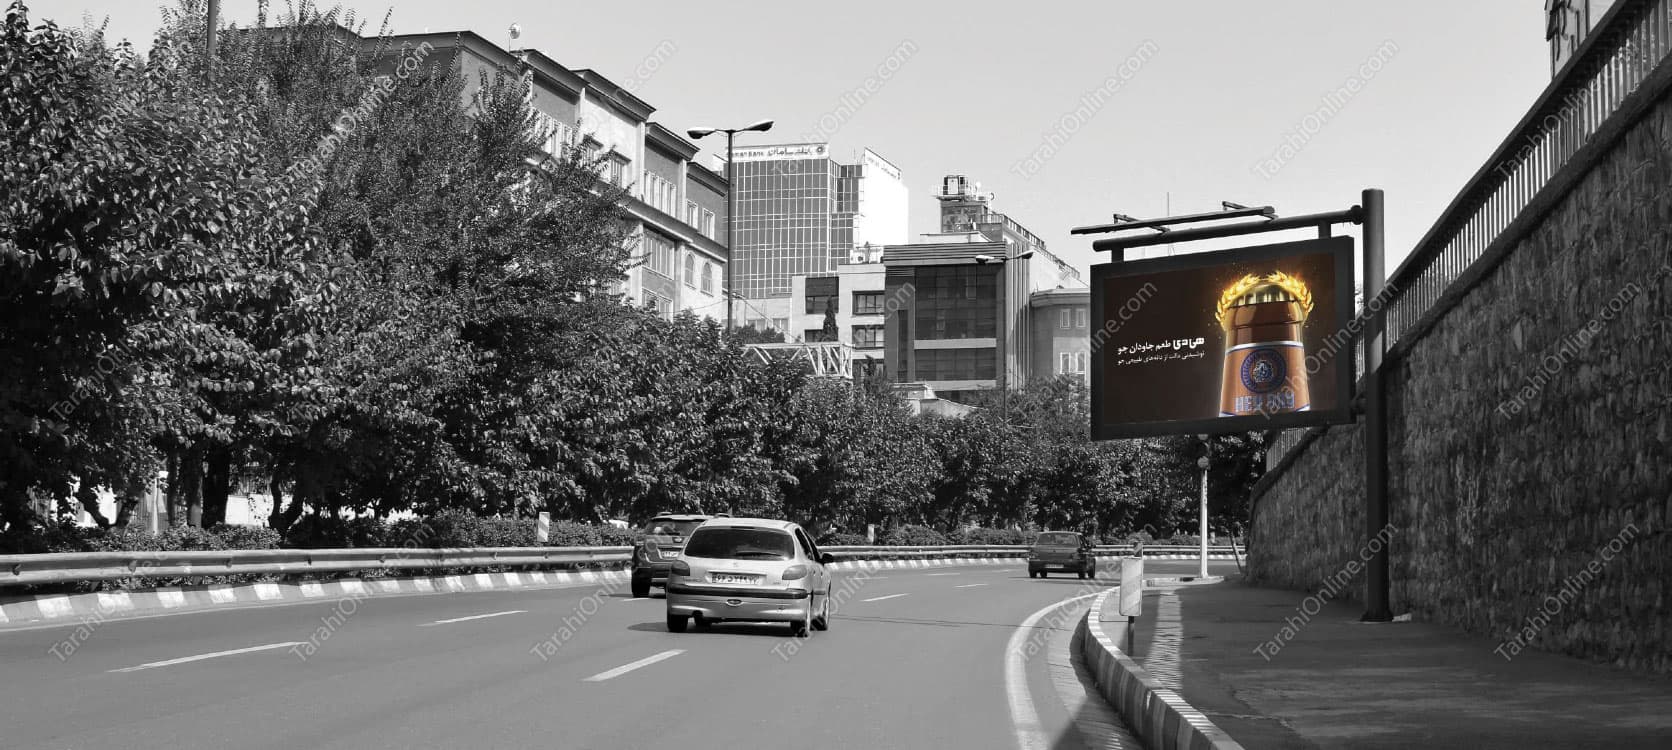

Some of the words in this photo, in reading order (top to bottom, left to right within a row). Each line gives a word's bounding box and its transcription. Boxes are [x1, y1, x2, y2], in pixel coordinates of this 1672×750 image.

[1117, 347, 1129, 355] جو
[1129, 341, 1154, 354] جاودان
[1155, 339, 1171, 351] طعم
